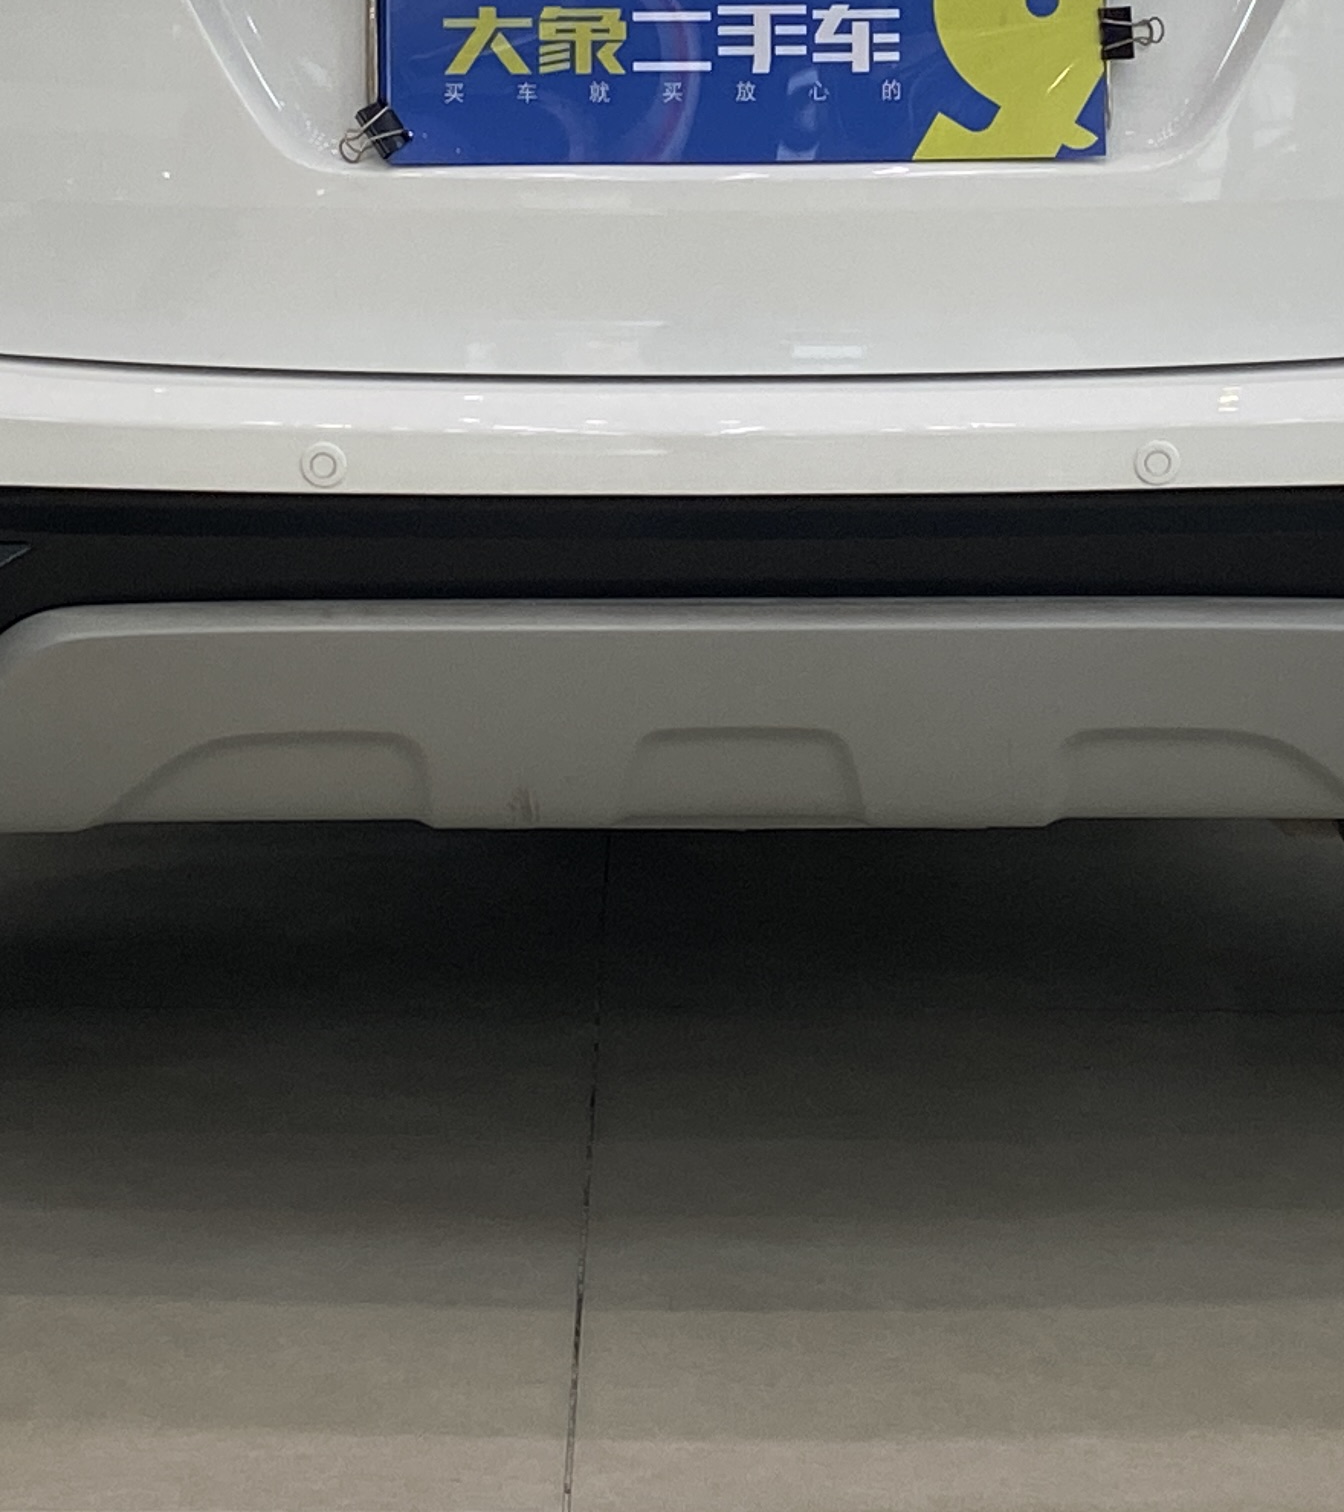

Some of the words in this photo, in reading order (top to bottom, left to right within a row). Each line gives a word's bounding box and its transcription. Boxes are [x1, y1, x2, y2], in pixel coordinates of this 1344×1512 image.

[442, 3, 901, 76] 大象二手车
[443, 80, 902, 104] 买车就买放心的
